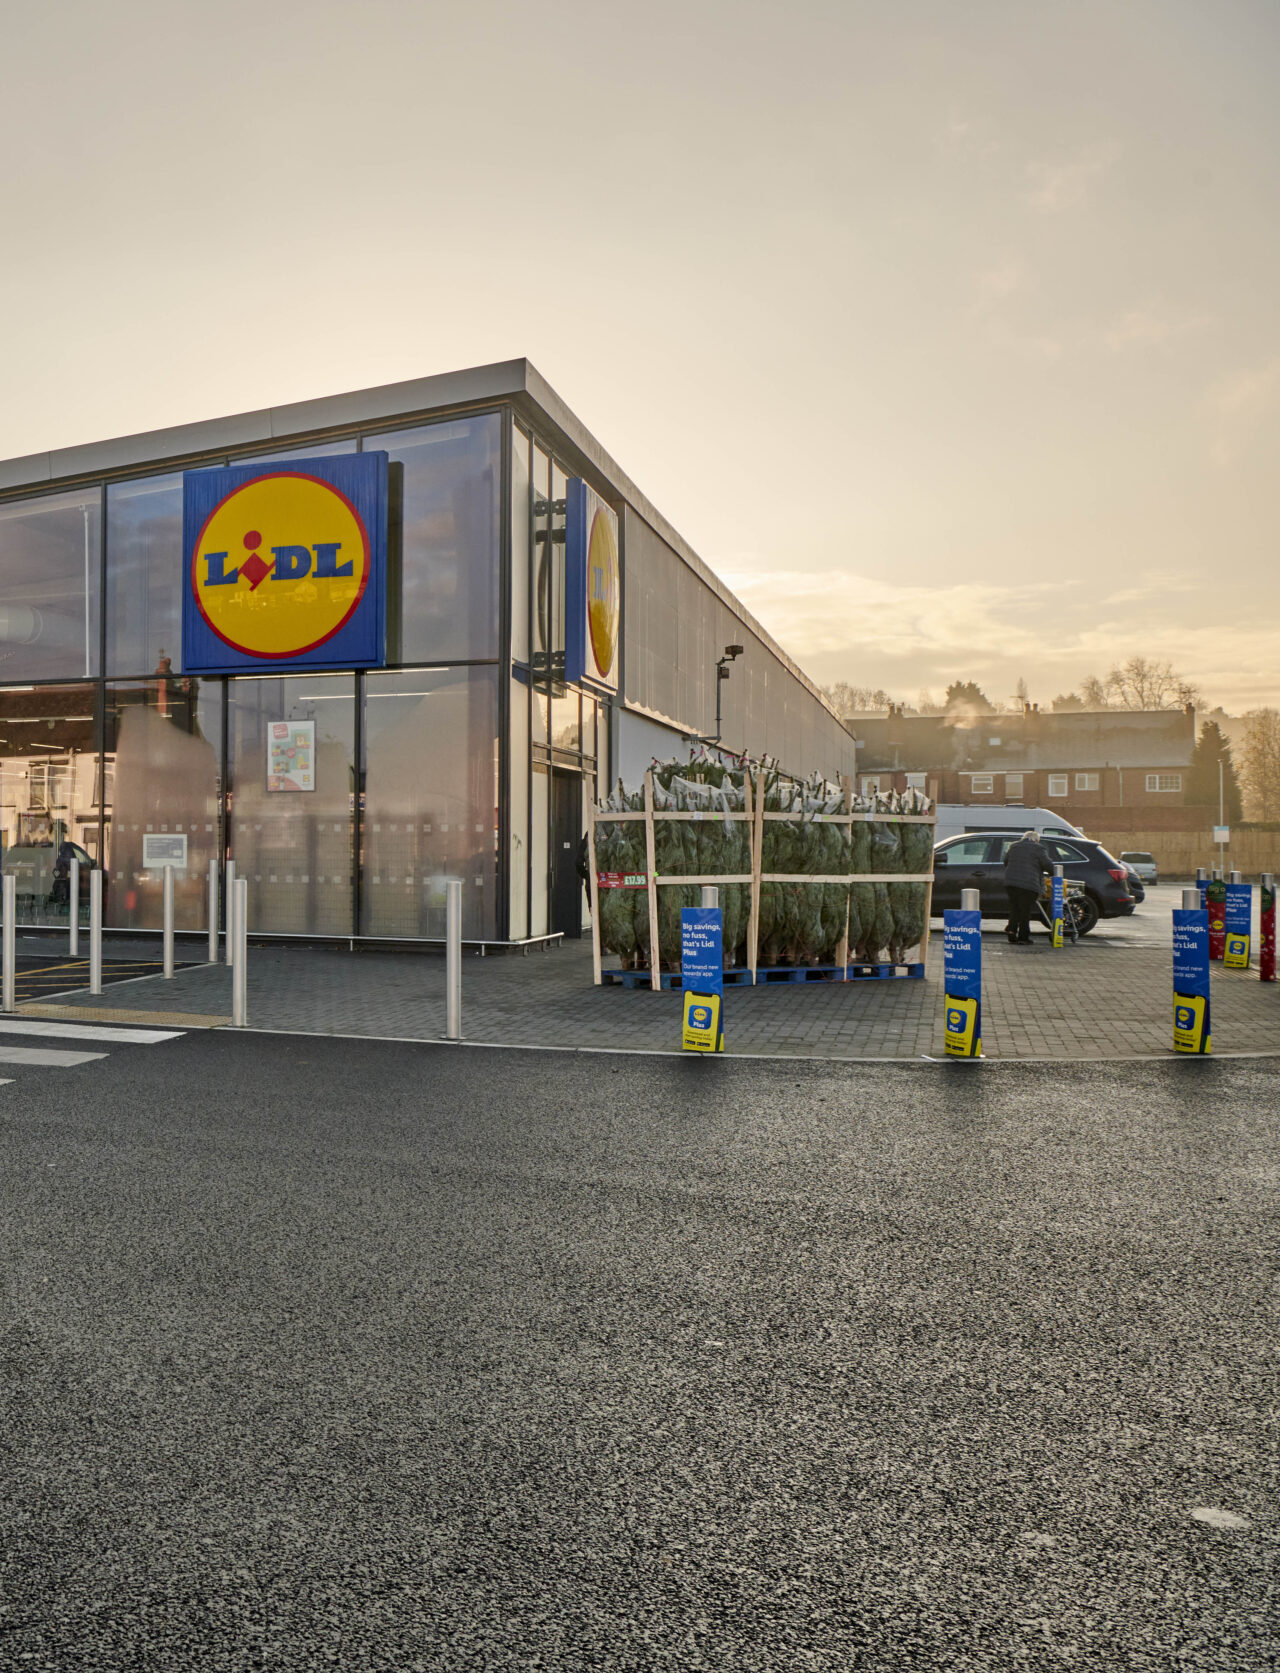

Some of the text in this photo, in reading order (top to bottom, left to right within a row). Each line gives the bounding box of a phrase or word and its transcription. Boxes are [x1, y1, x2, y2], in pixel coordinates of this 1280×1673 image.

[624, 876, 646, 885] £17.99
[682, 923, 721, 931] Big savings,
[950, 926, 980, 935] savings,
[949, 934, 964, 942] fuss,
